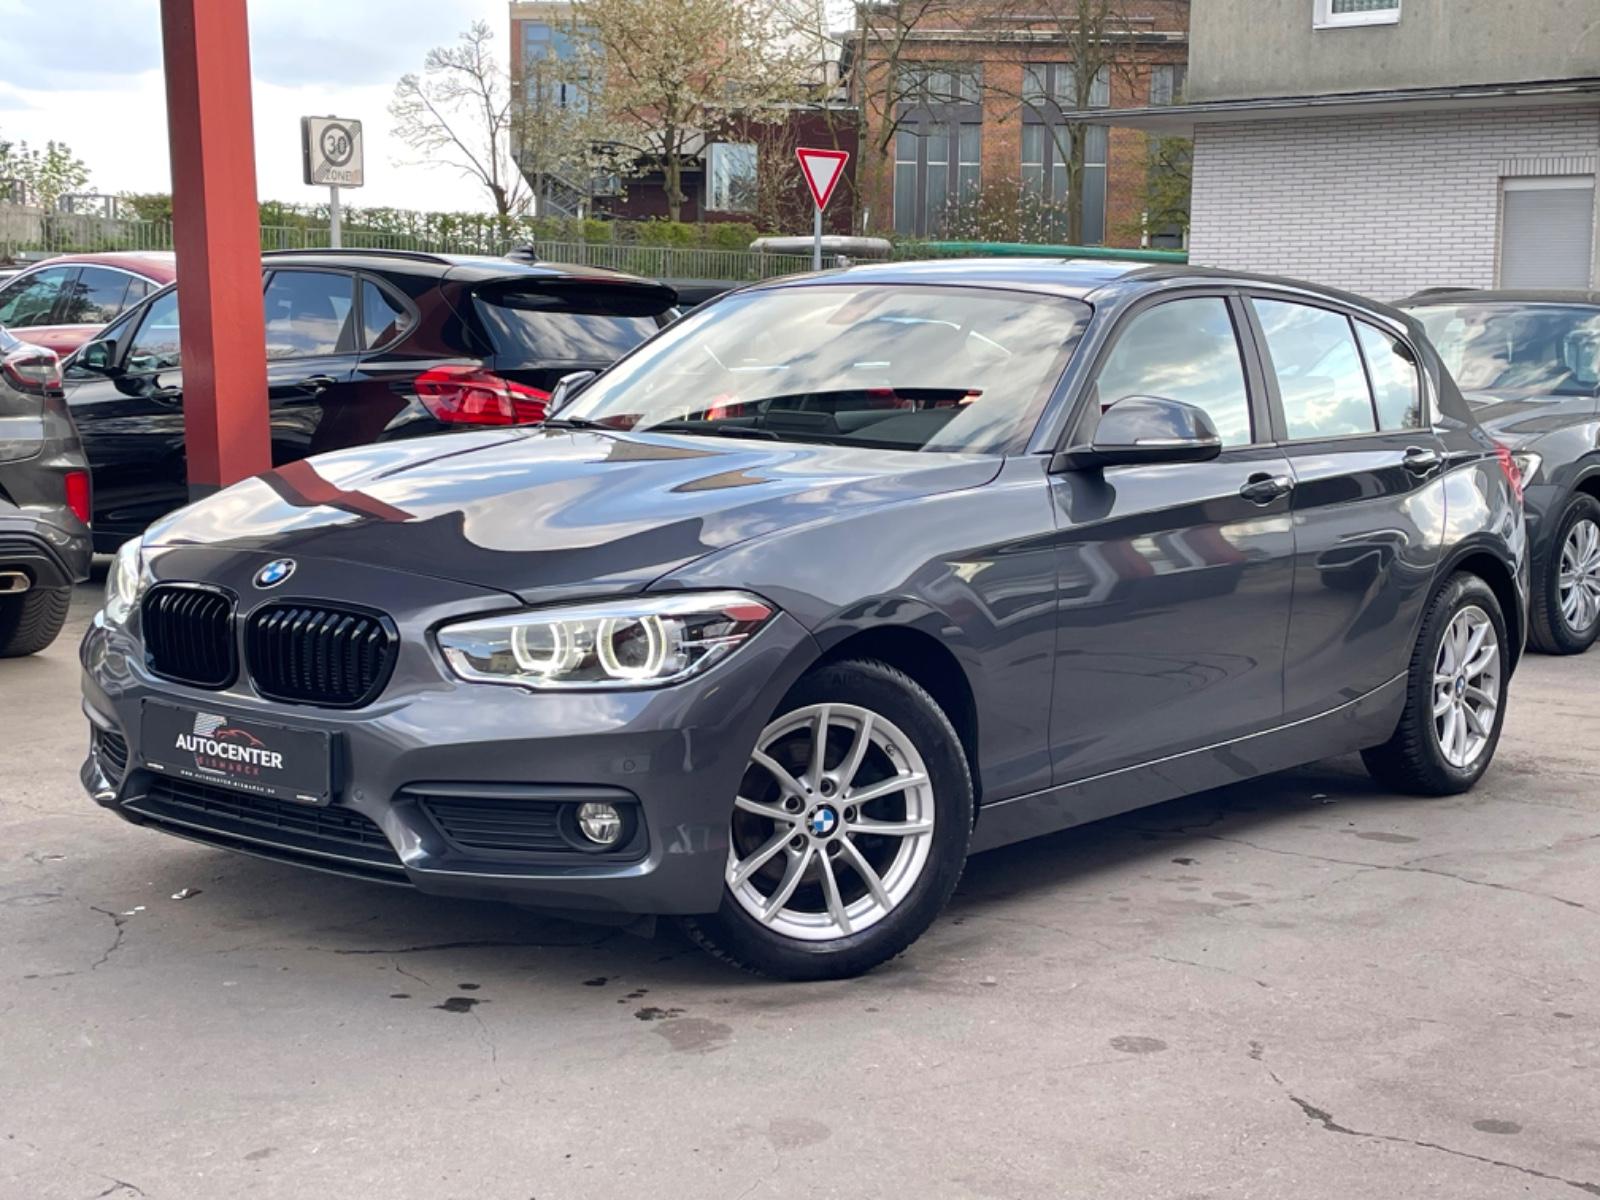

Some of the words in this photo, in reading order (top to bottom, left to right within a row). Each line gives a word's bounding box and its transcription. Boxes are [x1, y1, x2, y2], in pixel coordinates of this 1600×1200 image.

[327, 135, 347, 155] 30
[325, 169, 353, 181] ZONE
[175, 733, 284, 769] AUTOCENTER
[198, 755, 261, 776] BISMARCK
